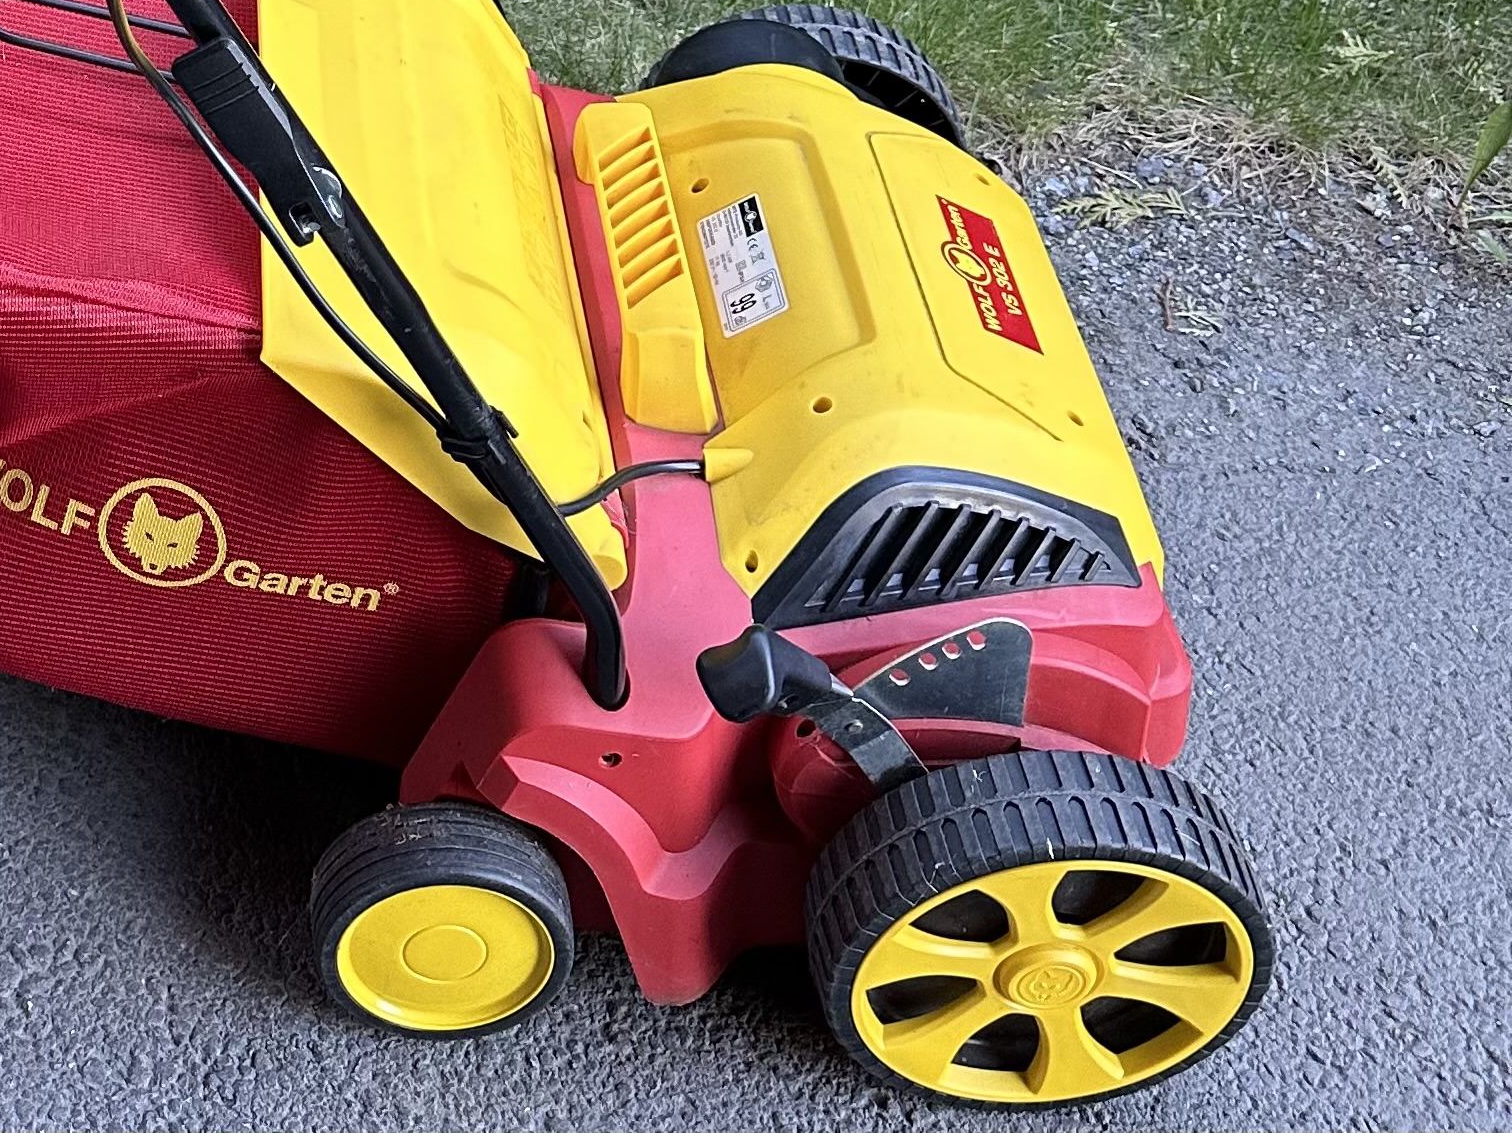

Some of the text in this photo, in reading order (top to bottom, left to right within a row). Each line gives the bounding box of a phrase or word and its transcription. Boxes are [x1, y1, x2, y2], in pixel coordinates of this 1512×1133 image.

[982, 242, 1023, 315] VS 302 E
[729, 292, 758, 315] 99
[973, 282, 1003, 331] WOLF
